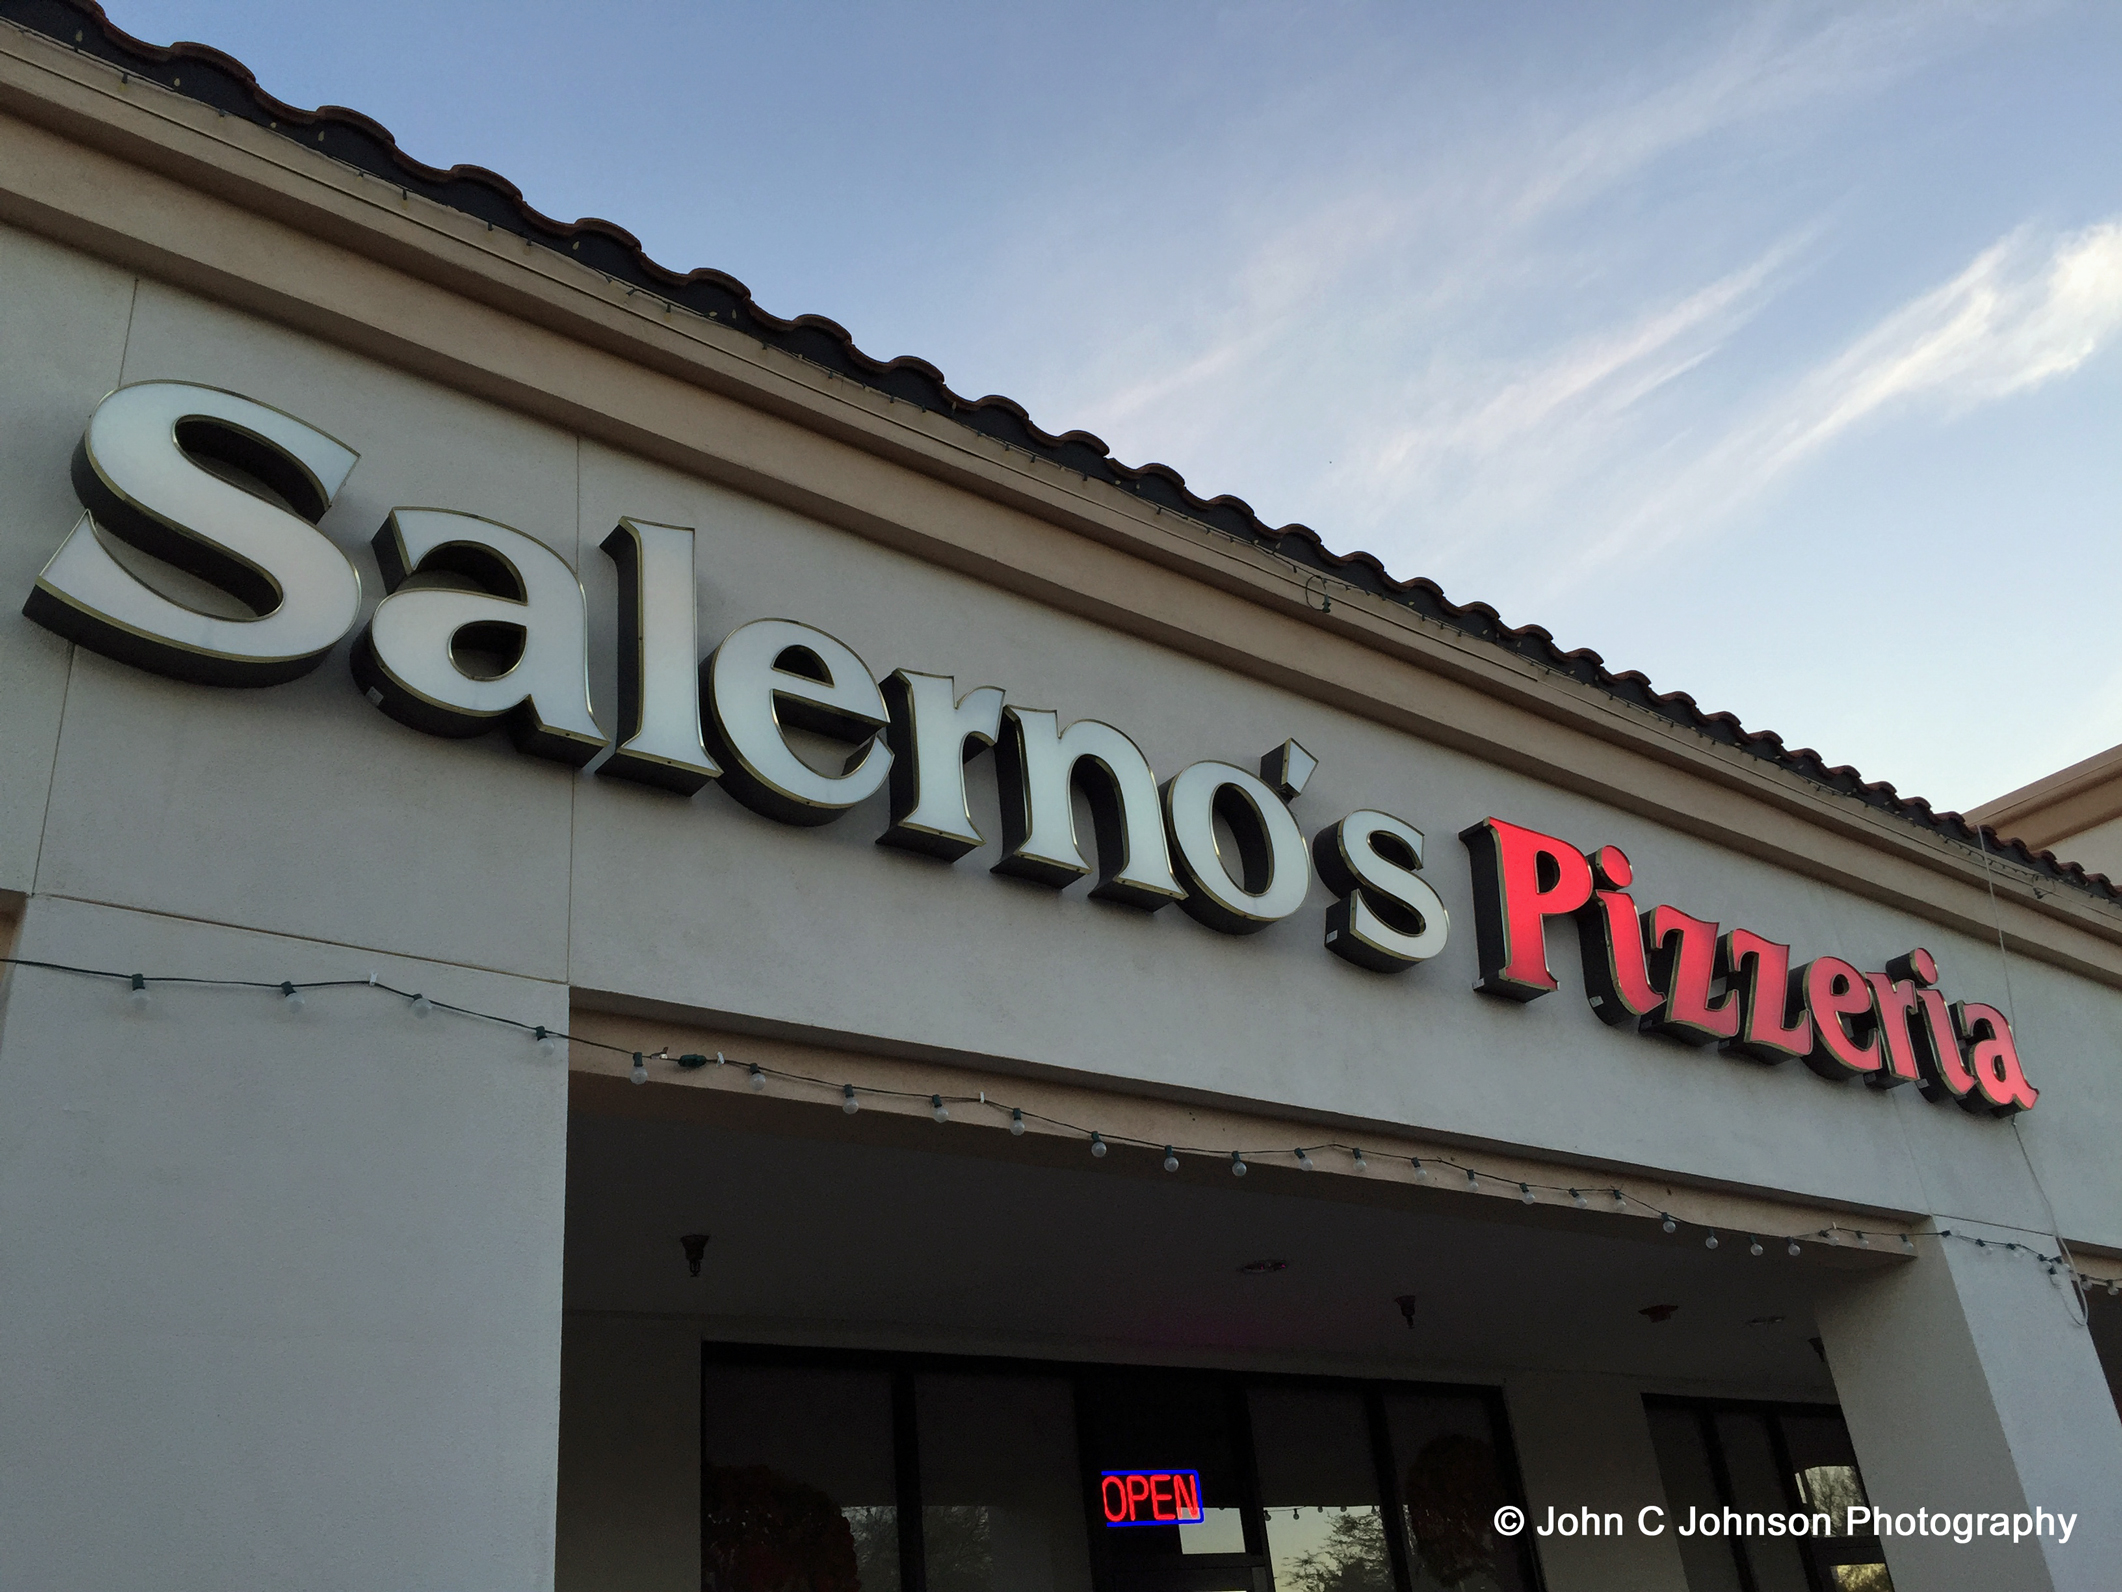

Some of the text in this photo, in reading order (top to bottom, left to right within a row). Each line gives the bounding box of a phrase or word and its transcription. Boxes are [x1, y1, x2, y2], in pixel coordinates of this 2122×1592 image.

[30, 380, 2040, 1113] Salerno's Pizzeria
[1102, 1474, 1199, 1522] OPEN
